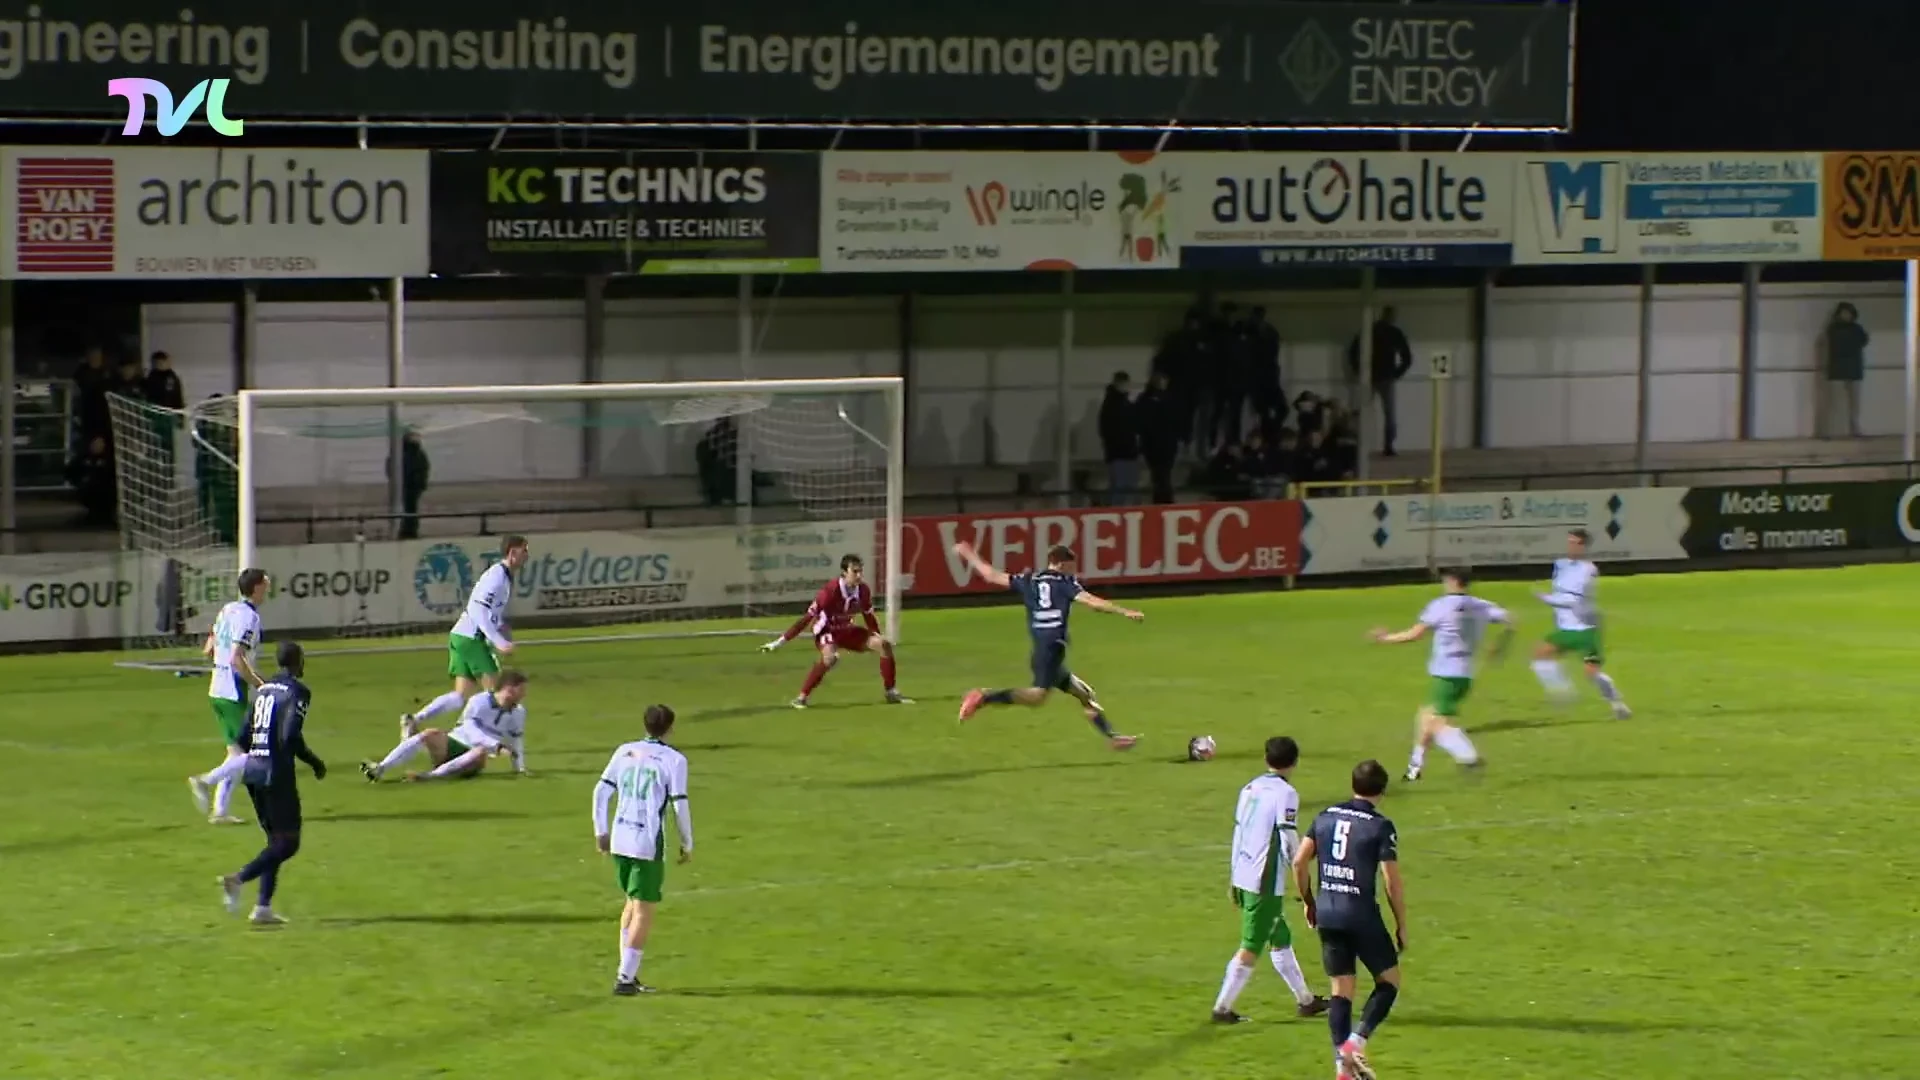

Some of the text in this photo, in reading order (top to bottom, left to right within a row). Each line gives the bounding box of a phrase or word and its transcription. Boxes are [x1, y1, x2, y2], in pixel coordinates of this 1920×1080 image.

[1352, 17, 1476, 60] SIATEC
[340, 17, 636, 87] Consulting
[700, 22, 1219, 90] Energiemanagement
[1349, 66, 1498, 107] ENERGY
[137, 155, 409, 225] architon
[487, 167, 767, 203] KC TECHNICS
[38, 188, 96, 212] VAN
[27, 217, 107, 241] ROEY
[487, 218, 767, 239] INSTALLATIE & TECHNIEK
[135, 256, 317, 273] BOUWEN MET MENSEN
[1432, 355, 1448, 374] 12
[1720, 490, 1834, 514] Mode voor
[1719, 526, 1848, 550] alle mannen
[1331, 818, 1352, 861] 5
